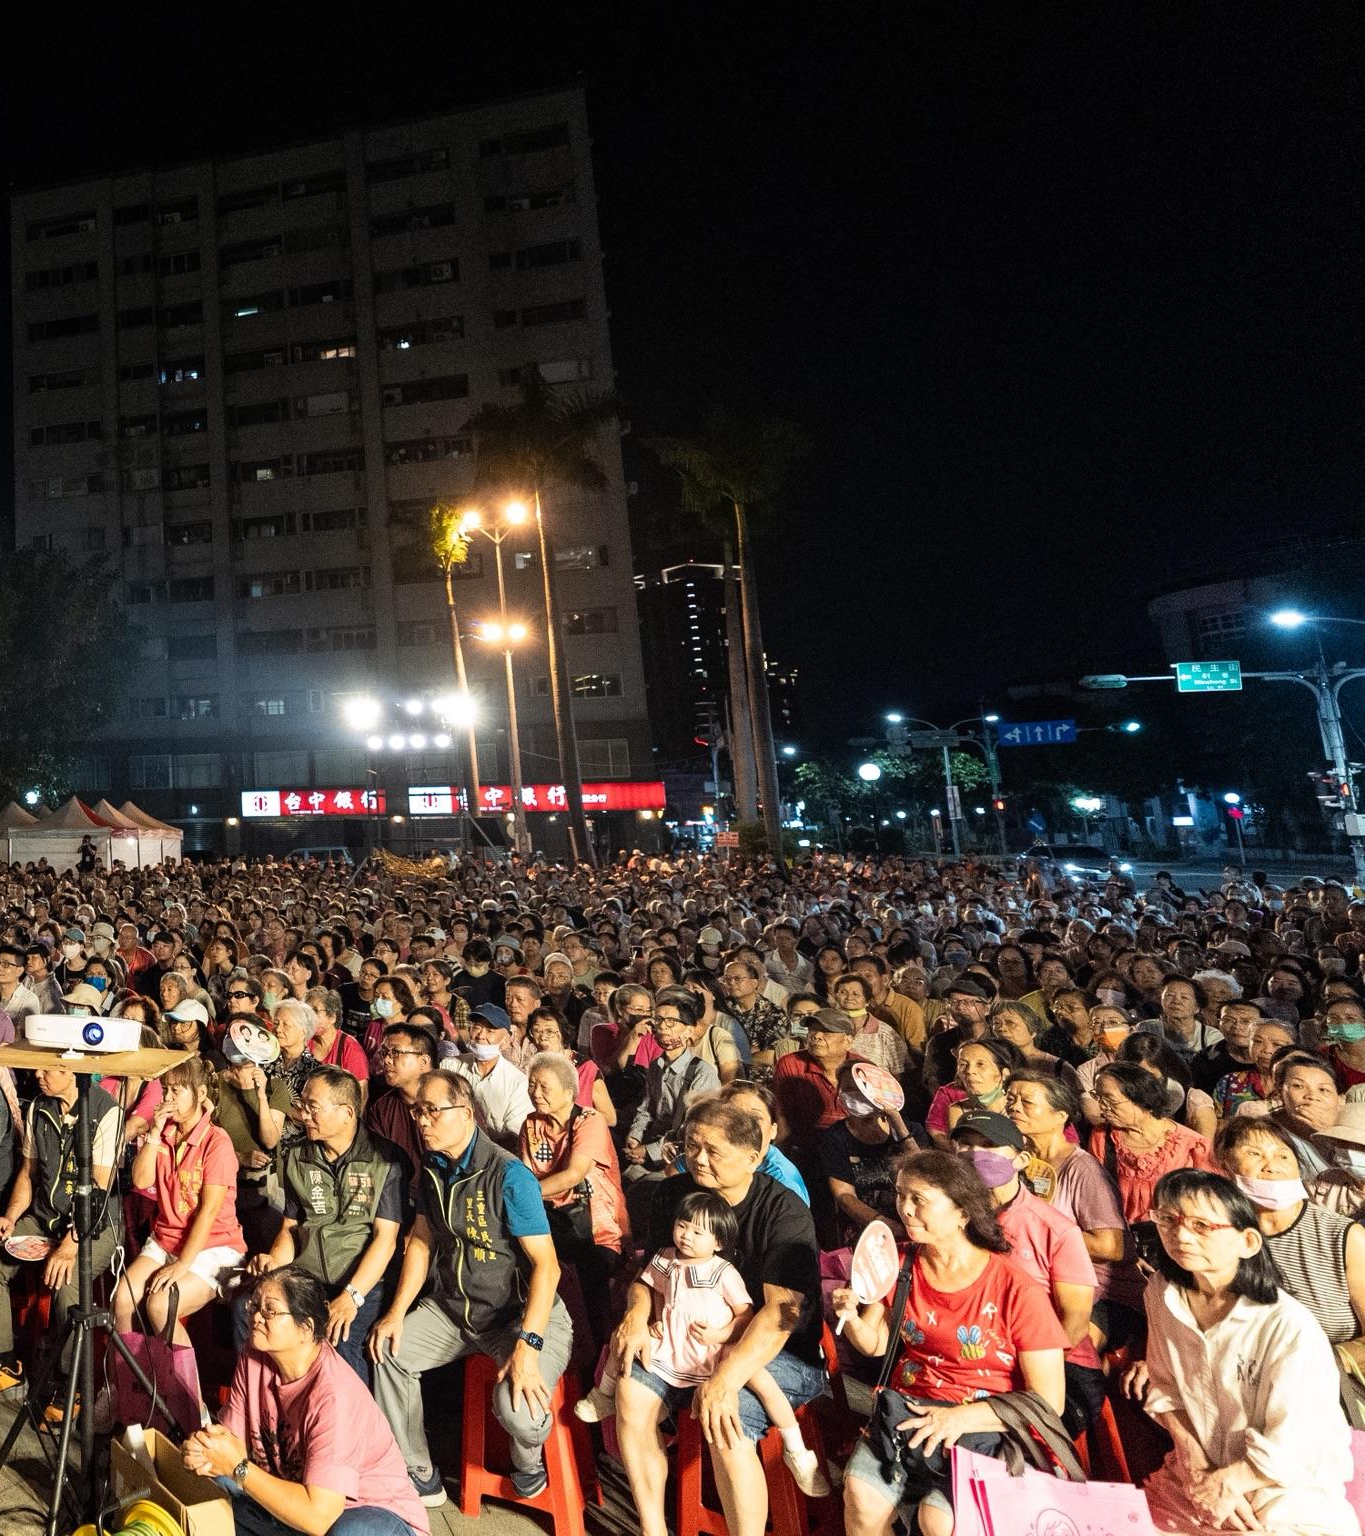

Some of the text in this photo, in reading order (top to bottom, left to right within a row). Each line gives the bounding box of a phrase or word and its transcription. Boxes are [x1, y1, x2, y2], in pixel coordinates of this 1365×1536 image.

[1191, 664, 1238, 672] 民生街
[284, 790, 378, 811] 台中銀行
[309, 1170, 327, 1214] 陳金吉
